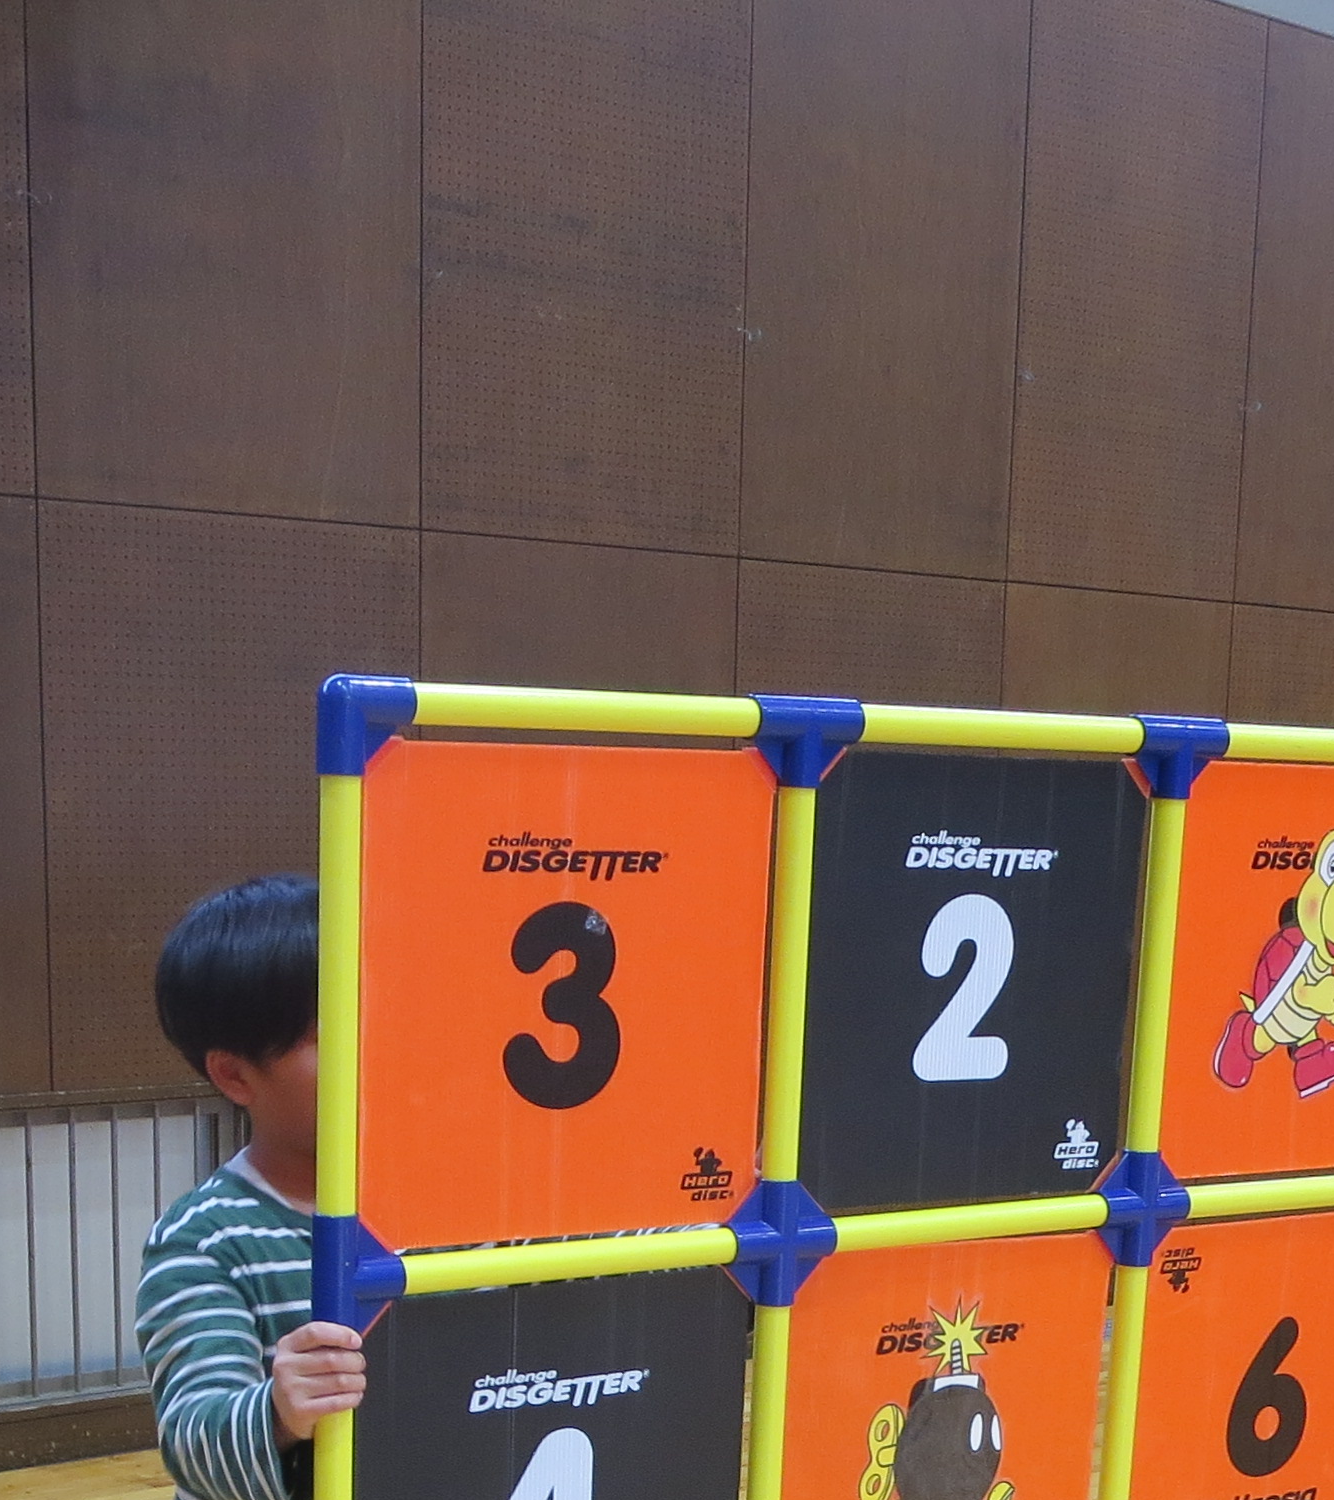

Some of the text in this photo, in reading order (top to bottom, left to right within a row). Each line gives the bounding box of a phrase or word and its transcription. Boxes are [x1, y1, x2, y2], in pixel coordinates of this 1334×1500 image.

[488, 832, 573, 850] challenge
[911, 830, 982, 847] challenge
[1257, 836, 1315, 850] challenge
[912, 893, 1014, 1082] 2
[503, 901, 621, 1110] 3
[1056, 1143, 1097, 1157] Hero
[681, 1173, 731, 1189] Hero
[691, 1190, 730, 1201] disc
[474, 1369, 557, 1388] challenge
